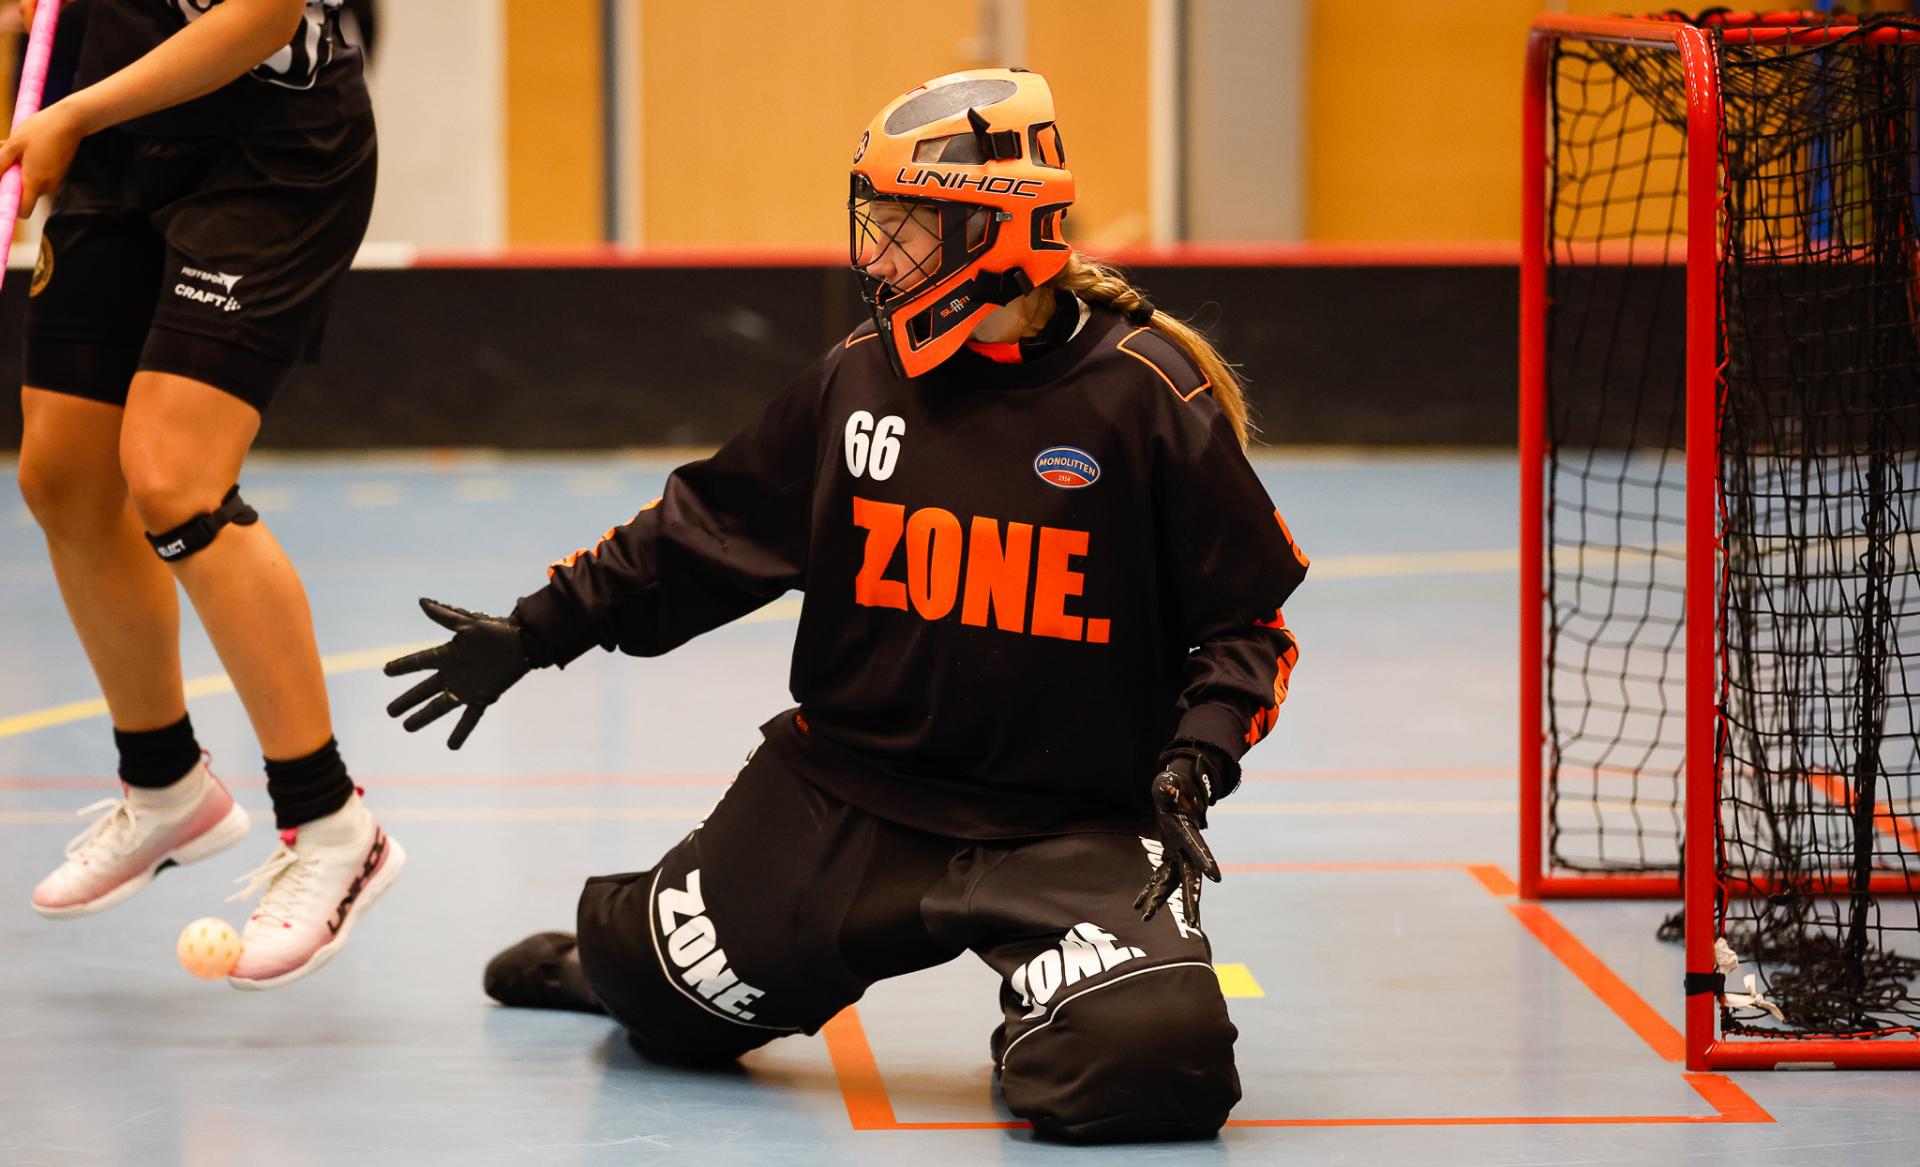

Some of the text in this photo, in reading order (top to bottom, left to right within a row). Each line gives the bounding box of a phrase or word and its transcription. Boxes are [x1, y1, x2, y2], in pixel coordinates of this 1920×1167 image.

[896, 167, 1043, 198] UNIHOC
[174, 283, 227, 307] CRAFT
[845, 410, 906, 481] 66
[1039, 457, 1096, 477] MONOLITTEN
[853, 496, 1111, 643] ZONE.
[327, 823, 387, 935] UNIHOC
[658, 868, 766, 1021] ZONE.
